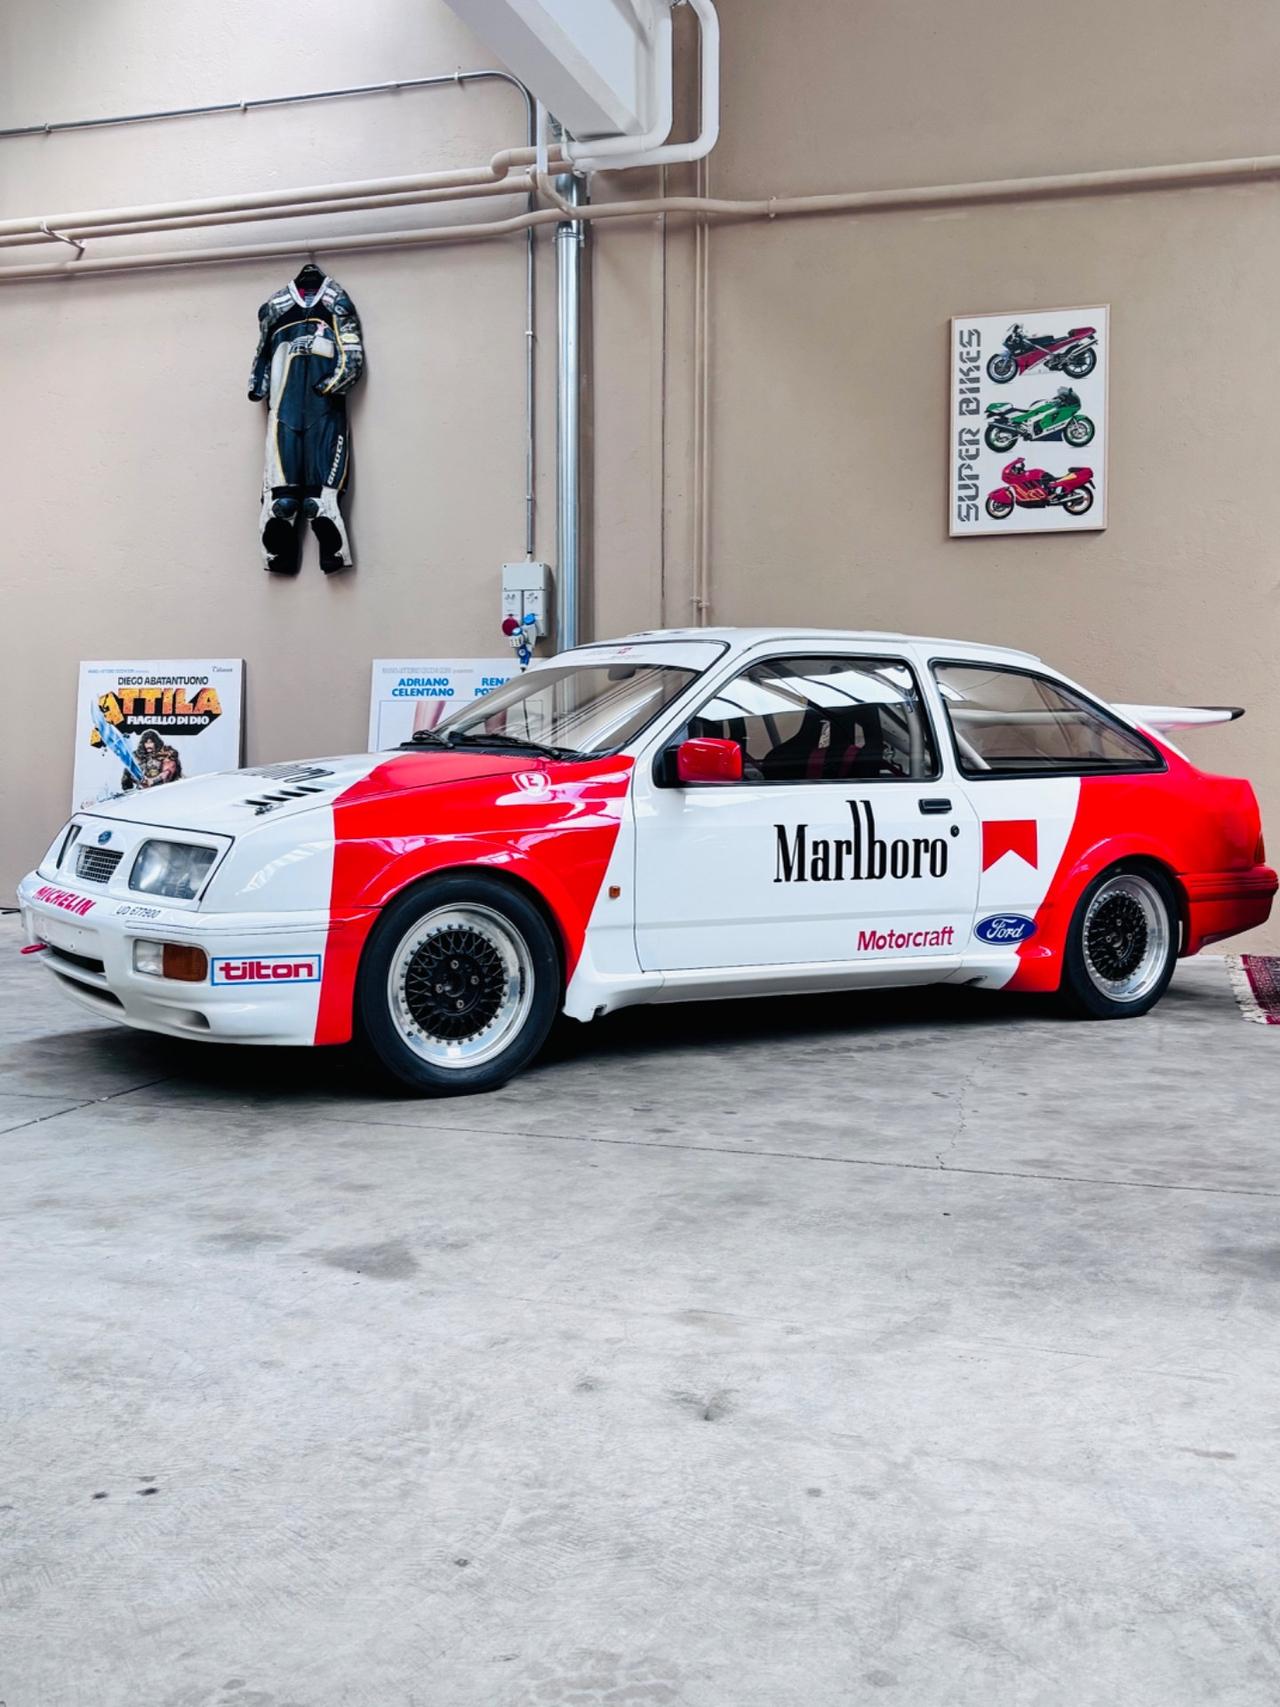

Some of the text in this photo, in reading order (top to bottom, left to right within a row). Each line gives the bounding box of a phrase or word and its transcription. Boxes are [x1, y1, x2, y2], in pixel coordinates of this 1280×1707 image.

[957, 328, 982, 523] SUPER BIKES
[117, 676, 209, 686] DIEGO ABATANTUONO
[398, 678, 449, 687] ADRIANO
[392, 688, 454, 697] CELENTANO
[127, 715, 210, 725] FLAGELLO DI DIO
[773, 800, 949, 883] Marlboro
[32, 885, 97, 917] MICHELIN
[986, 918, 1026, 939] Ford
[857, 926, 955, 952] Motorcraft
[218, 961, 314, 981] tilton
